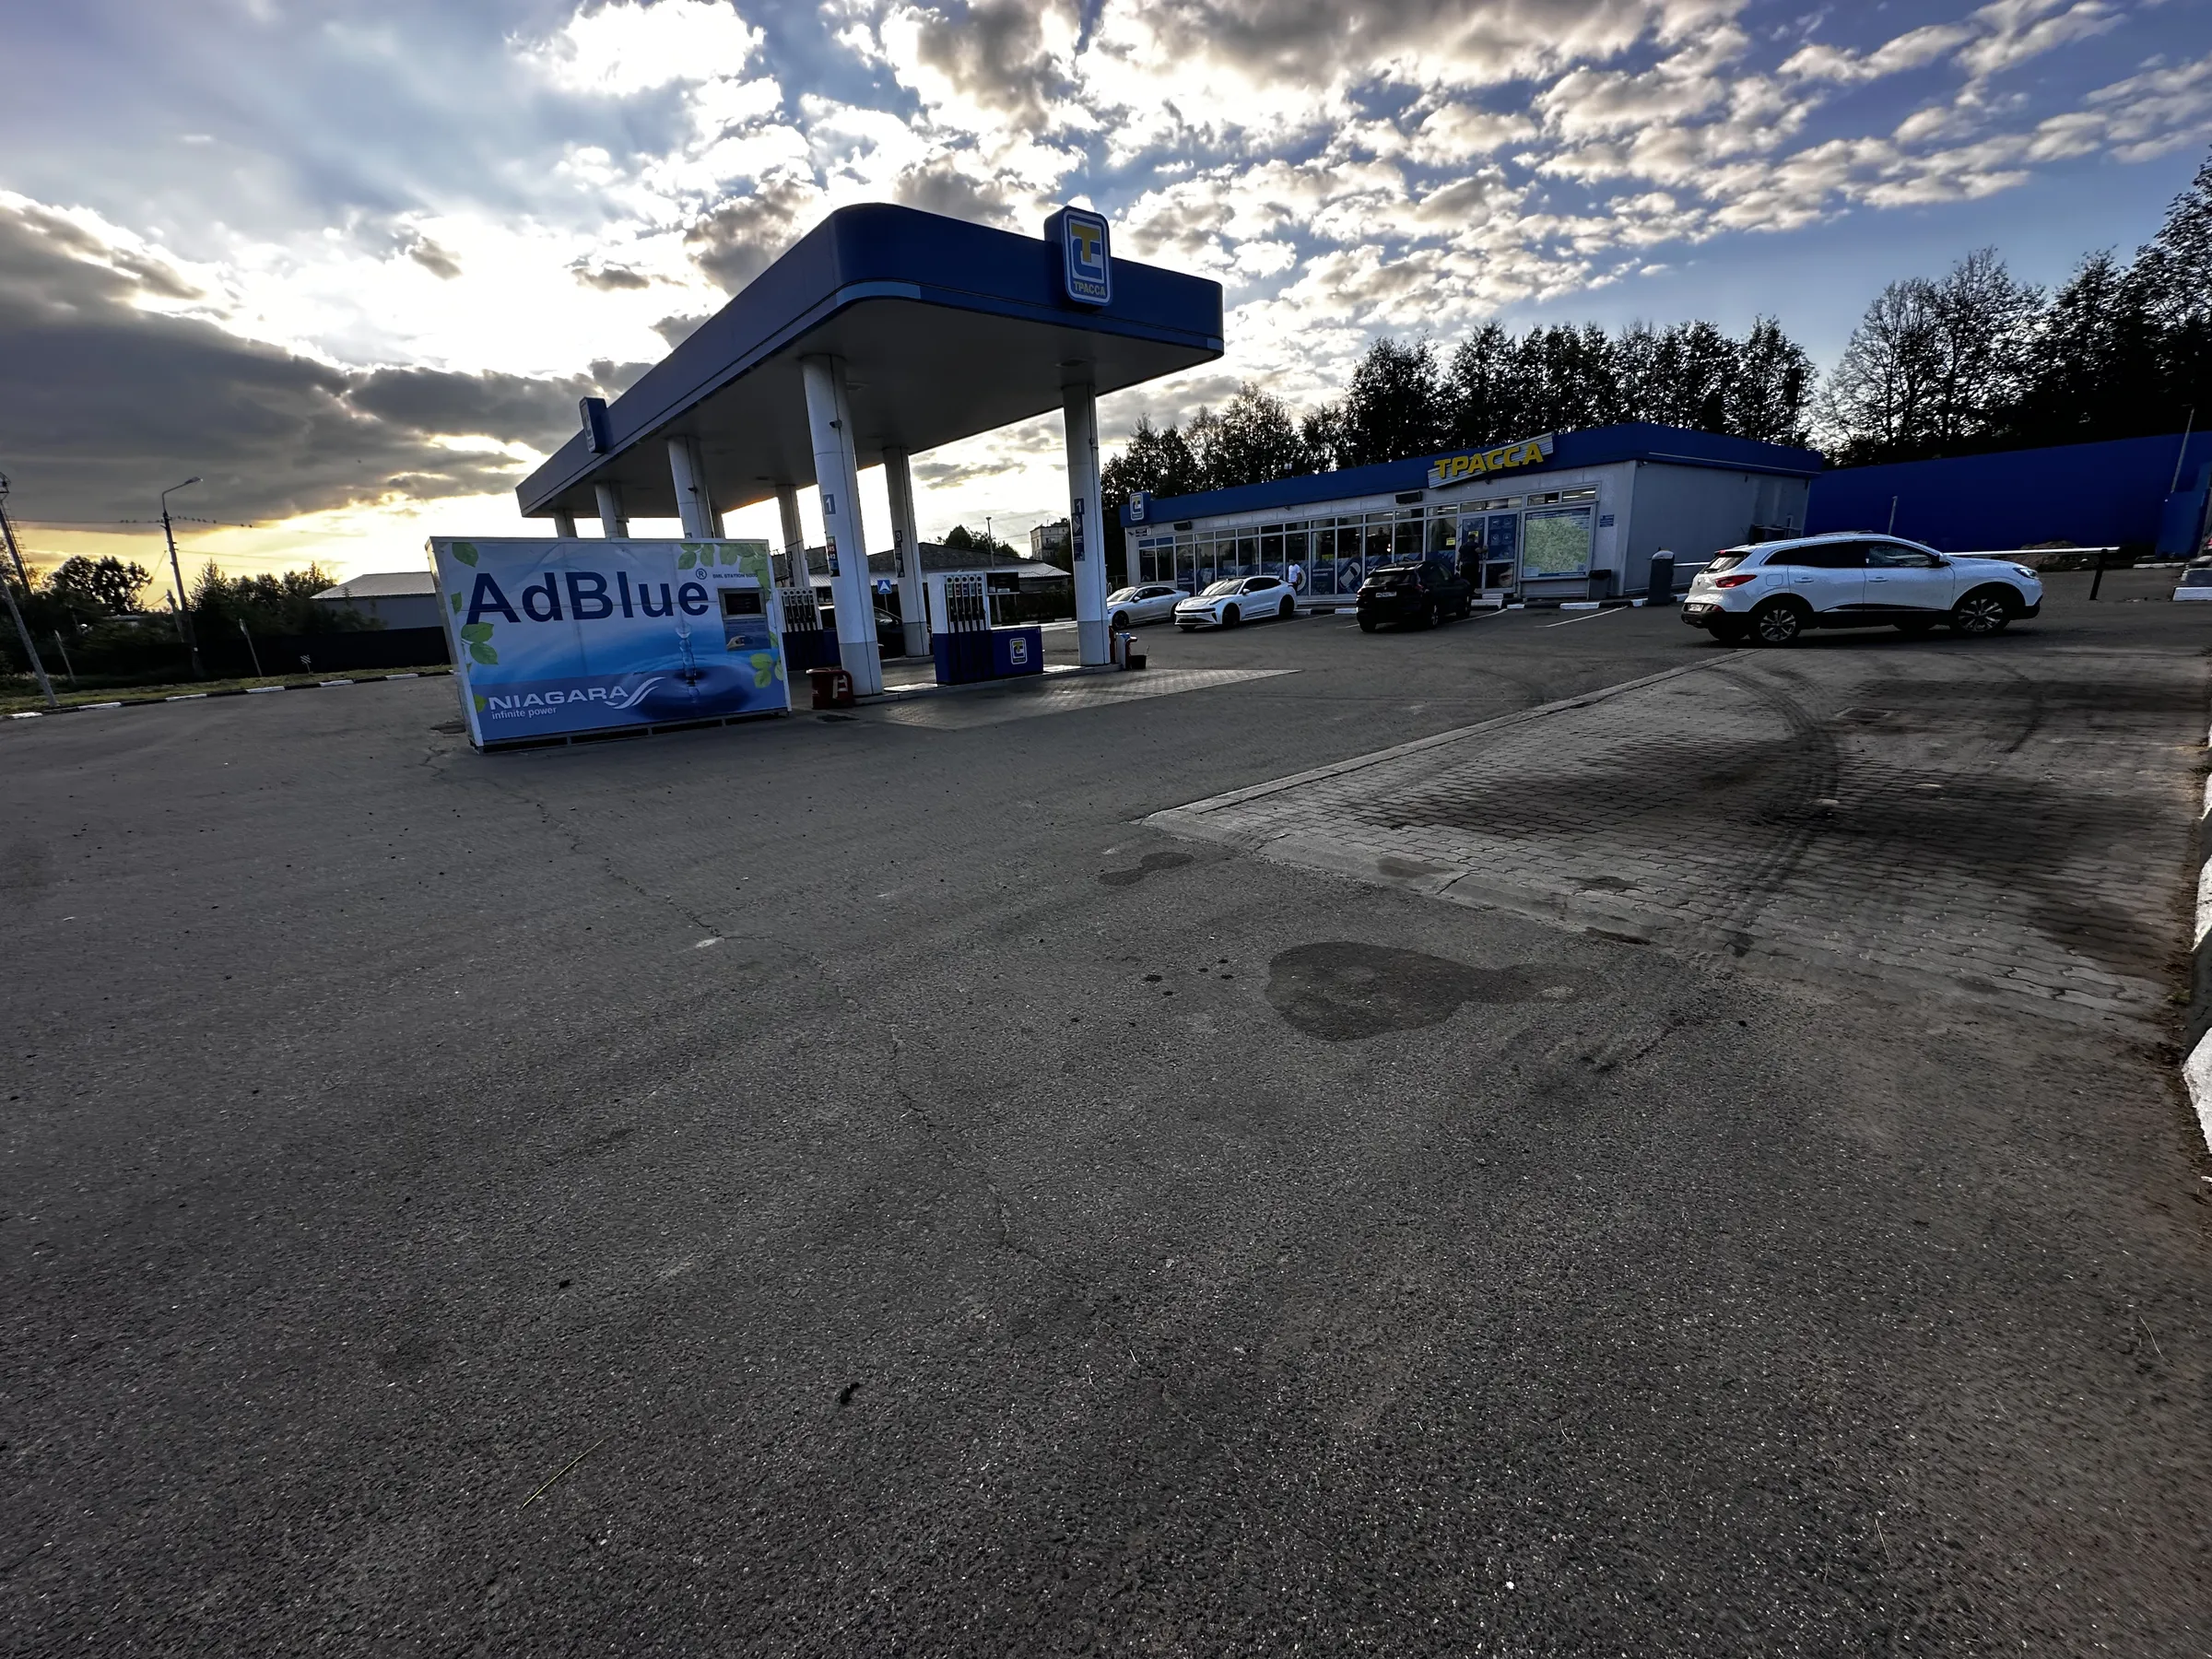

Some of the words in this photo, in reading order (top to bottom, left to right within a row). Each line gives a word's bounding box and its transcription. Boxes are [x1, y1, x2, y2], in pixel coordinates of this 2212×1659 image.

[1073, 281, 1106, 296] ТРАССА
[1434, 442, 1544, 478] ТРАССА
[825, 498, 832, 512] 1
[1077, 500, 1082, 512] 1
[896, 532, 901, 541] 3
[488, 686, 629, 711] NIAGARA
[491, 709, 526, 720] infinite
[528, 707, 558, 718] power
